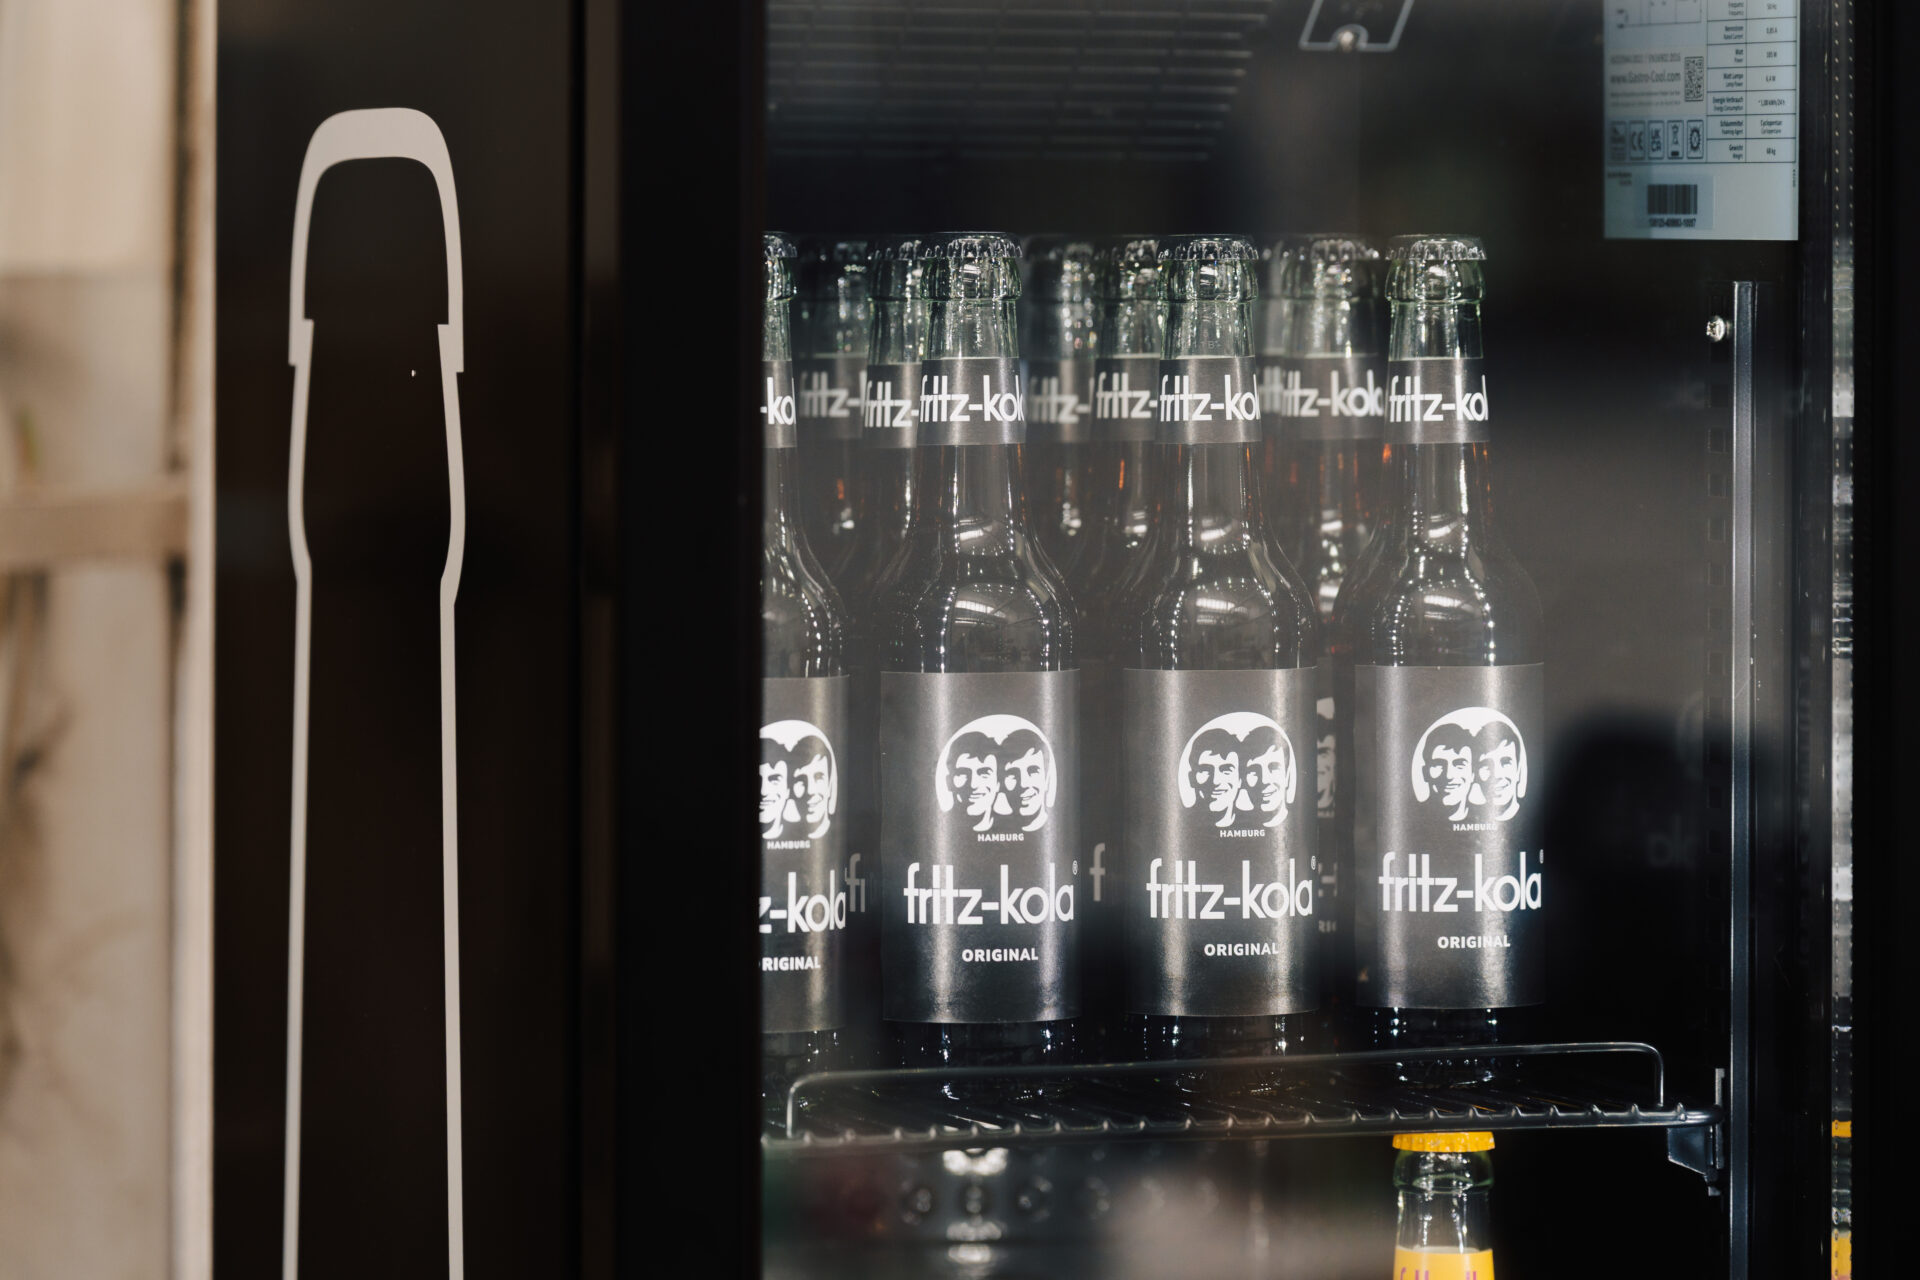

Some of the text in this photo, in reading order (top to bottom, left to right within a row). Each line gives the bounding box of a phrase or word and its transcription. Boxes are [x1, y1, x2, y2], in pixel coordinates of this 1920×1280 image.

[1453, 823, 1498, 831] HAMBURG
[977, 833, 1025, 842] HAMBURG
[1219, 829, 1266, 838] HAMBURG
[766, 840, 811, 850] HAMBURG
[1437, 934, 1511, 949] ORIGINAL
[961, 947, 1039, 962] ORIGINAL
[1203, 942, 1280, 957] ORIGINAL
[759, 955, 821, 971] RIGINAL
